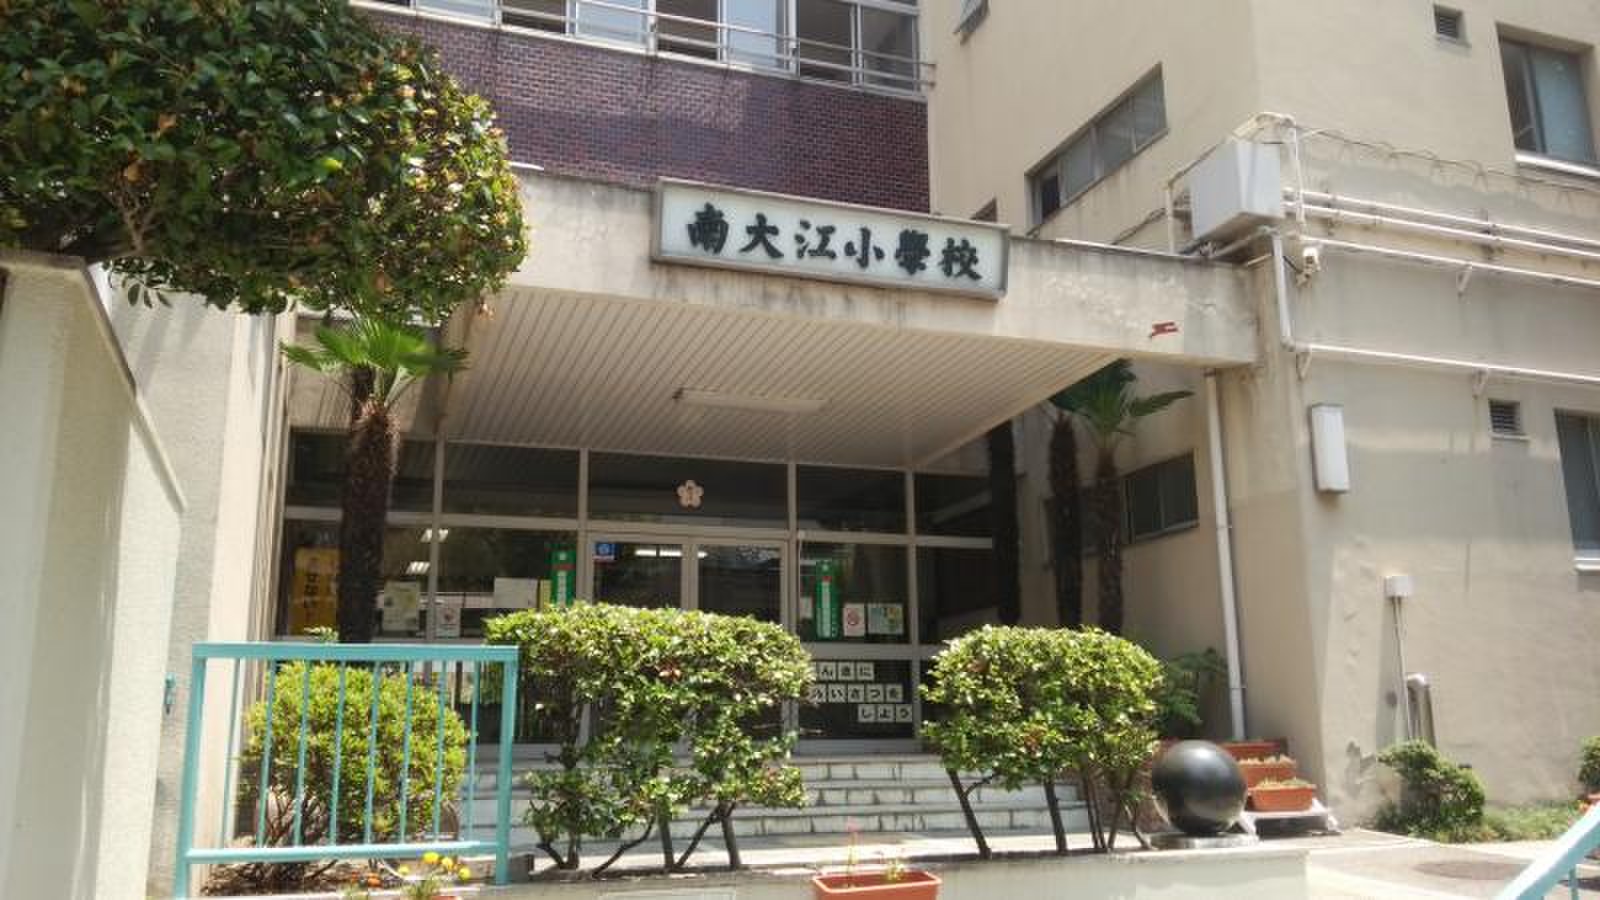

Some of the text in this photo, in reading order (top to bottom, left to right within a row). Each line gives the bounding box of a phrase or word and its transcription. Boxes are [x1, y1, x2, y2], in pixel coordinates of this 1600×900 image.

[686, 202, 981, 281] 南大江小學校
